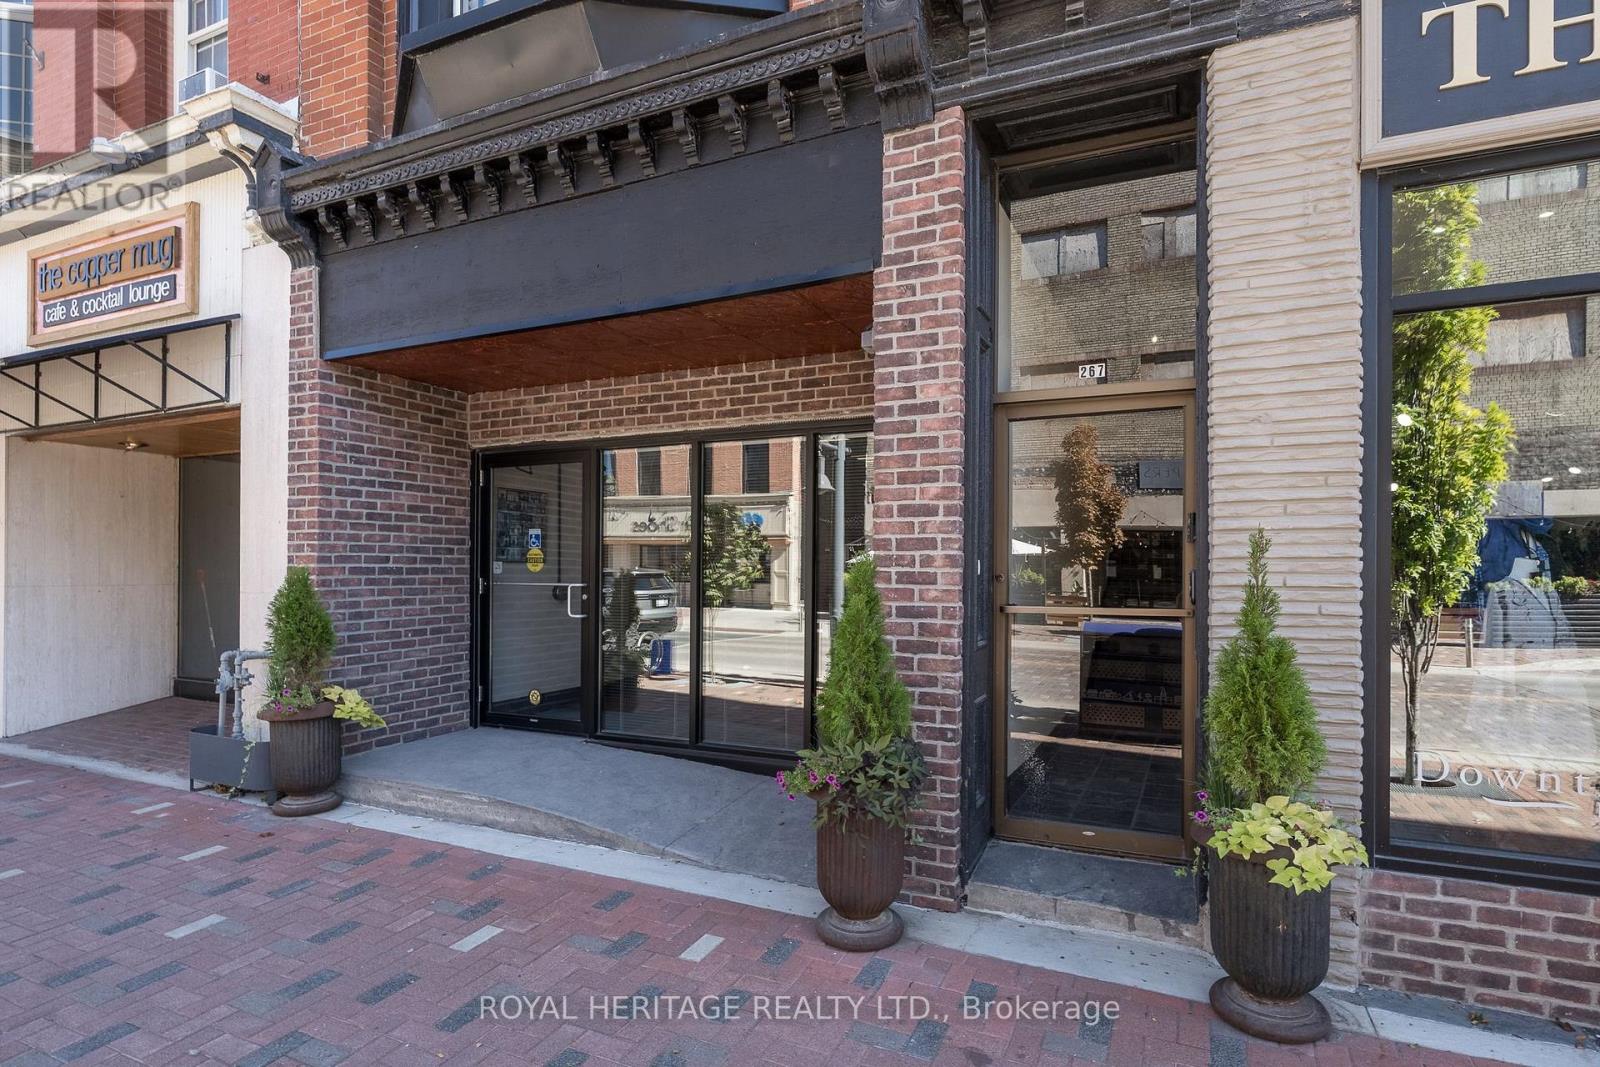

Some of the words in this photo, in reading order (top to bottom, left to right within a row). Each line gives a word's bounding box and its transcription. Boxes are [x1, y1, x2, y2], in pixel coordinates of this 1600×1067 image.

[1421, 0, 1600, 90] TH
[39, 262, 63, 293] the
[67, 248, 125, 288] copper
[132, 235, 174, 270] mug
[45, 302, 67, 323] cafe
[70, 299, 79, 317] &
[82, 287, 124, 315] cocktail
[129, 280, 170, 303] lounge
[1080, 364, 1104, 378] 267
[1413, 750, 1591, 796] Downt
